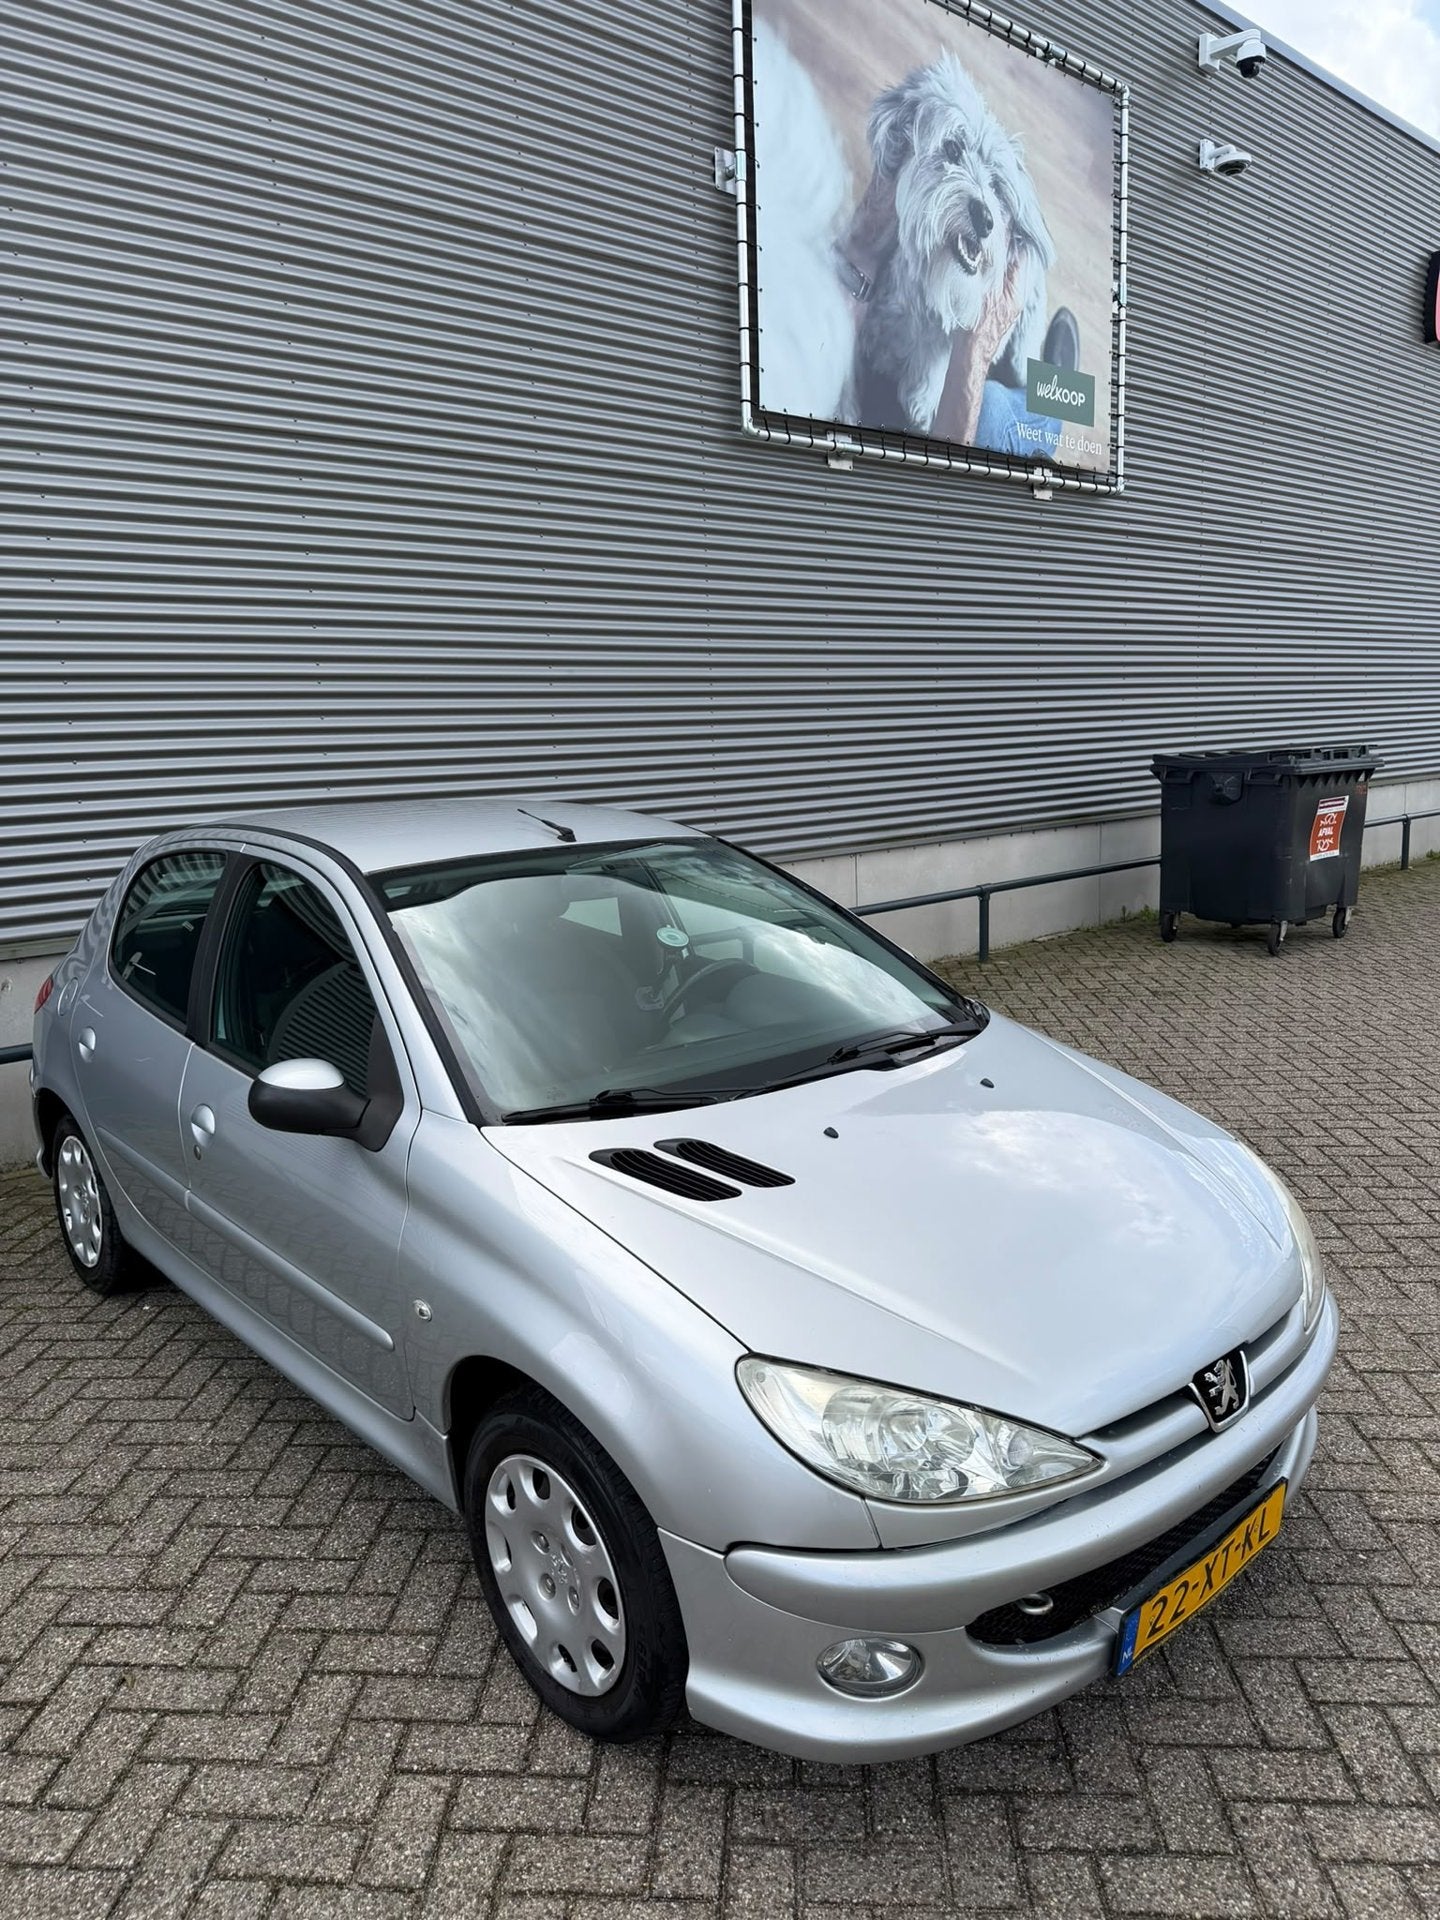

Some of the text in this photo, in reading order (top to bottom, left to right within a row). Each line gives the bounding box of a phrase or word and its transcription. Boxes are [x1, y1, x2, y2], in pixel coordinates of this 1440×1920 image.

[1016, 422, 1102, 455] Weet wat te doen
[1146, 1507, 1271, 1640] 22-XT-KL
[1121, 1648, 1133, 1664] NL
